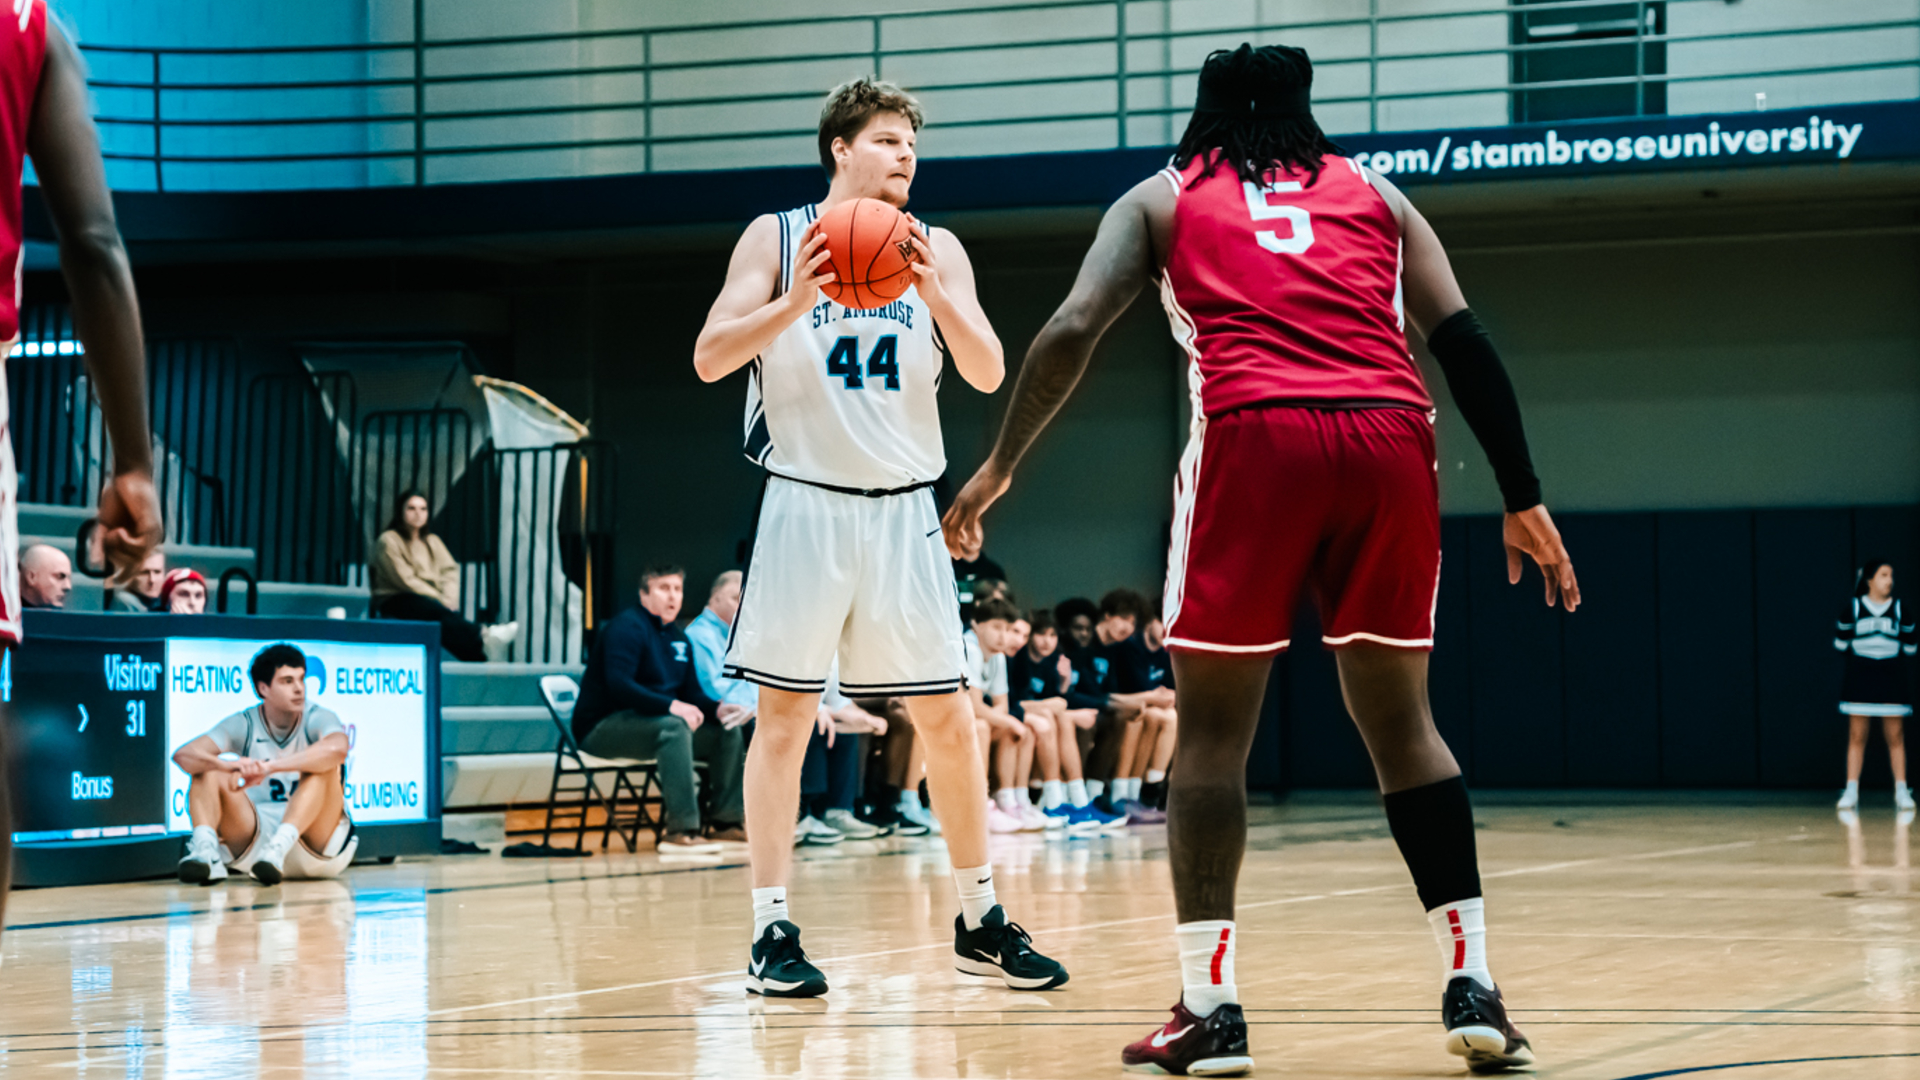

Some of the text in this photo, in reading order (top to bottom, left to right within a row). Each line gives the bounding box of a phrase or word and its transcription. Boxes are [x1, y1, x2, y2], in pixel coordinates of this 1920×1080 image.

[1243, 181, 1316, 254] 5
[812, 301, 837, 329] ST.
[825, 333, 901, 392] 44
[104, 653, 163, 691] Visitor
[172, 664, 243, 693] HEATING
[336, 667, 424, 695] ELECTRICAL
[125, 699, 146, 737] 31
[71, 770, 114, 800] Bonus
[344, 780, 418, 809] PLUMBING
